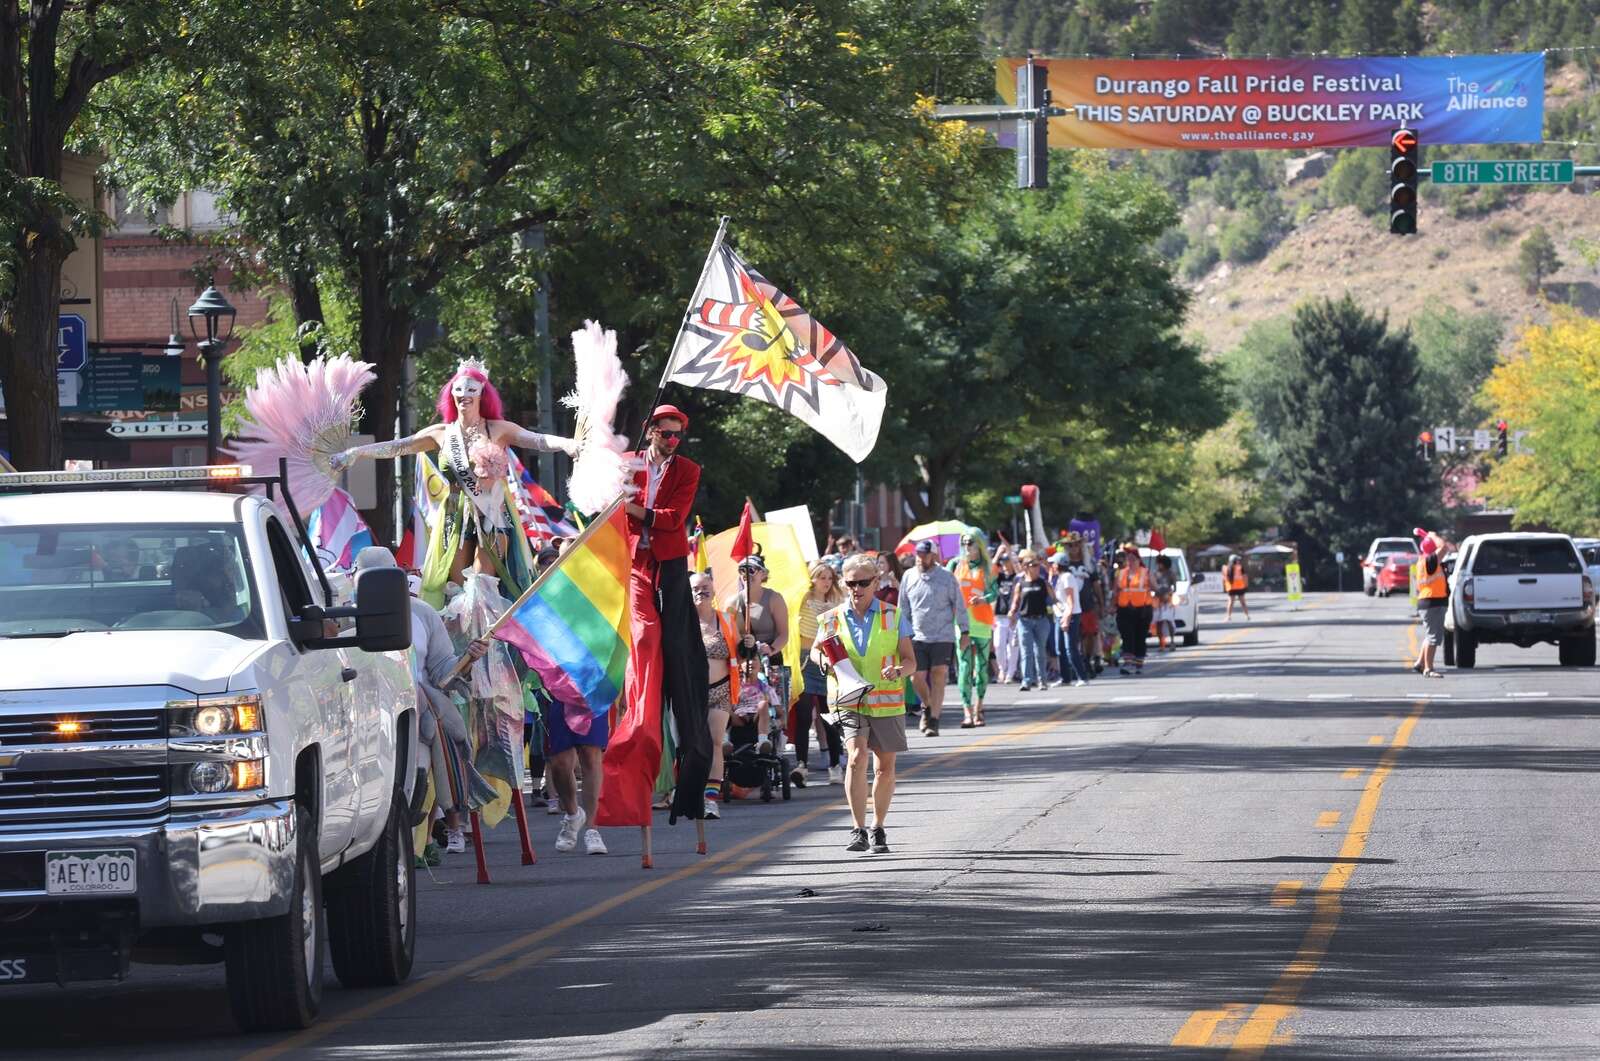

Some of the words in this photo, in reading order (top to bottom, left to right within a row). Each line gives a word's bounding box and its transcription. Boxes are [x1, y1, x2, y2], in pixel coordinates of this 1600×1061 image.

[1095, 76, 1190, 98] Durango
[1198, 75, 1238, 93] Fall
[1246, 74, 1305, 93] Pride
[1312, 73, 1402, 92] Festival
[1447, 77, 1479, 93] The
[1446, 95, 1528, 111] Alliance
[1075, 104, 1122, 122] THIS
[1127, 104, 1237, 123] SATURDAY
[1242, 106, 1262, 124] @
[1268, 104, 1364, 122] BUCKLEY
[1369, 103, 1424, 120] PARK
[1181, 130, 1315, 142] www.thealliance.gay
[1444, 163, 1478, 182] 8TH
[1493, 163, 1561, 182] STREET
